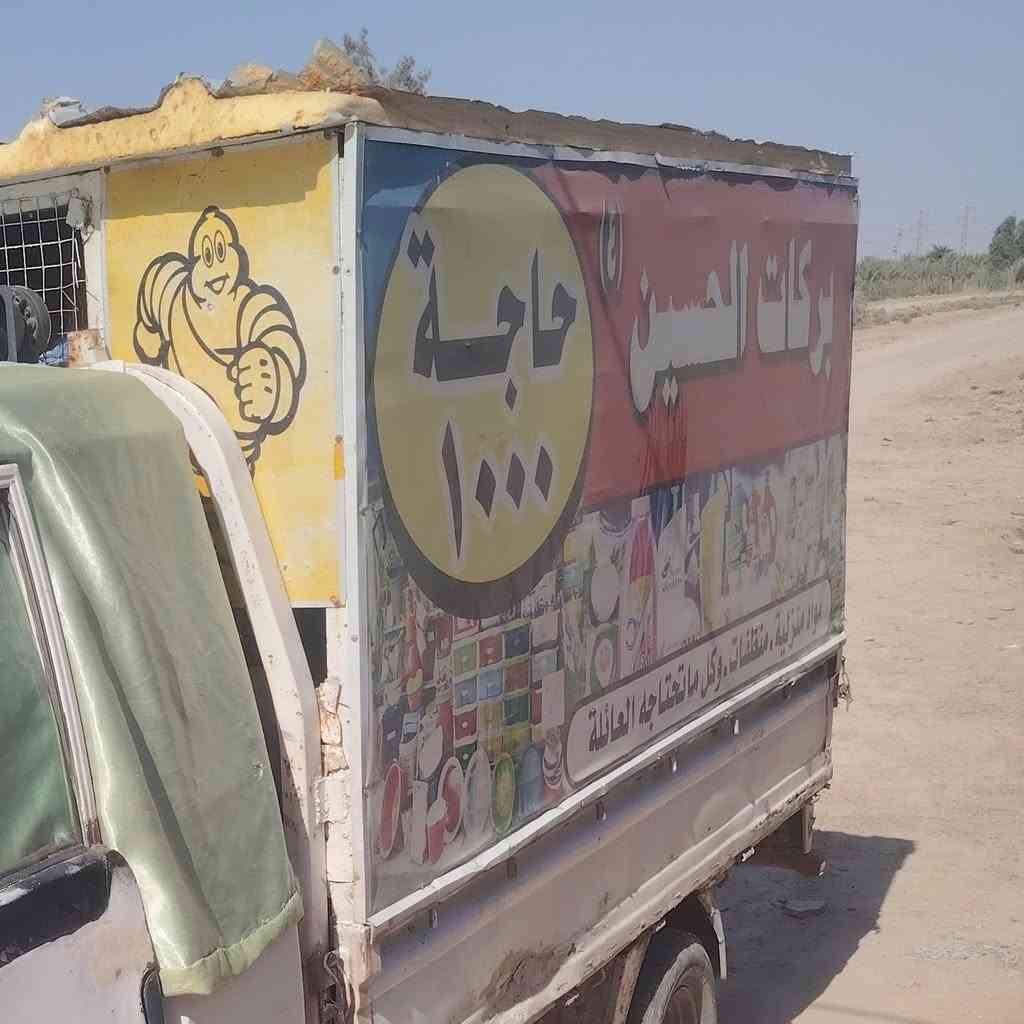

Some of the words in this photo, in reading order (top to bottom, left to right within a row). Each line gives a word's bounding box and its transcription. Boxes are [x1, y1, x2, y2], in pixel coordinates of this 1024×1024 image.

[406, 228, 578, 411] حاجة
[629, 240, 750, 413] الحسين
[757, 238, 834, 381] بركات
[441, 418, 555, 560] ١٠٠٠
